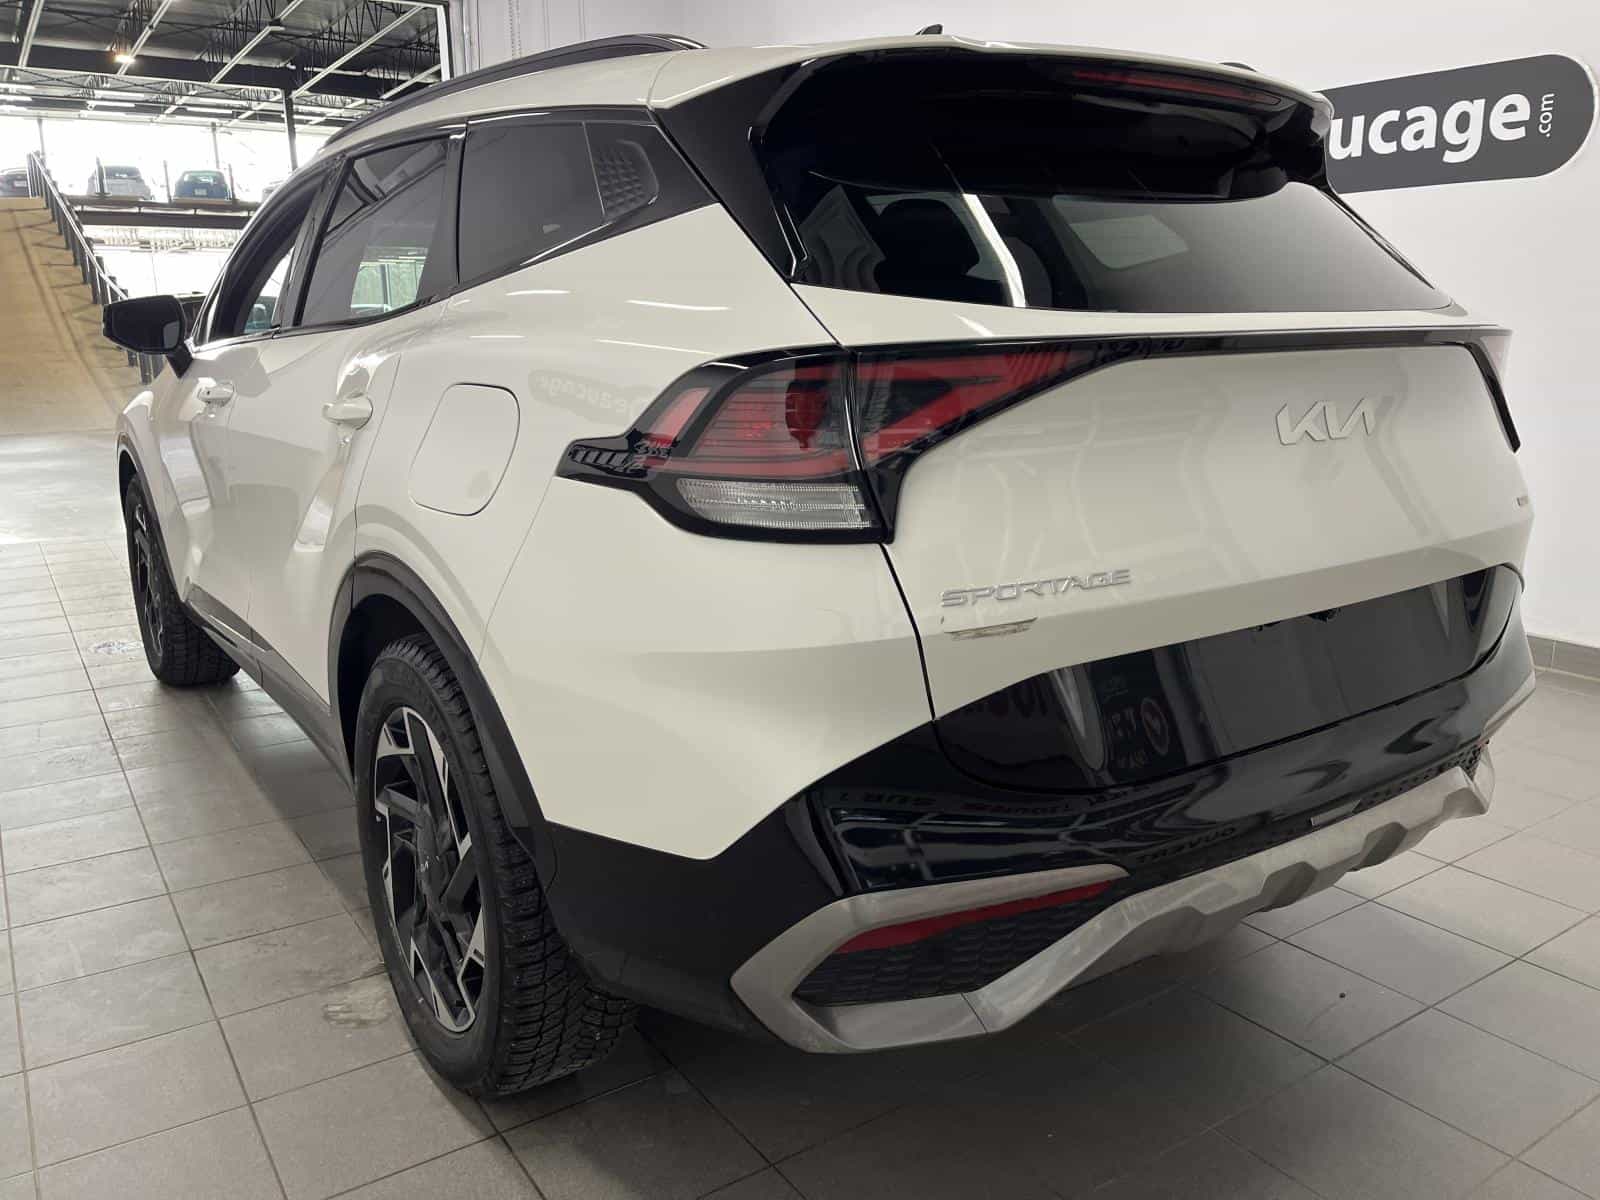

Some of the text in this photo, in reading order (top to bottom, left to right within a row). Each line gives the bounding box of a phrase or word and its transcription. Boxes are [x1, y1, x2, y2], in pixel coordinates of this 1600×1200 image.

[1328, 93, 1531, 163] ucage
[1538, 93, 1555, 138] .com
[1275, 396, 1377, 446] KIA
[940, 568, 1132, 608] SPORTAGE
